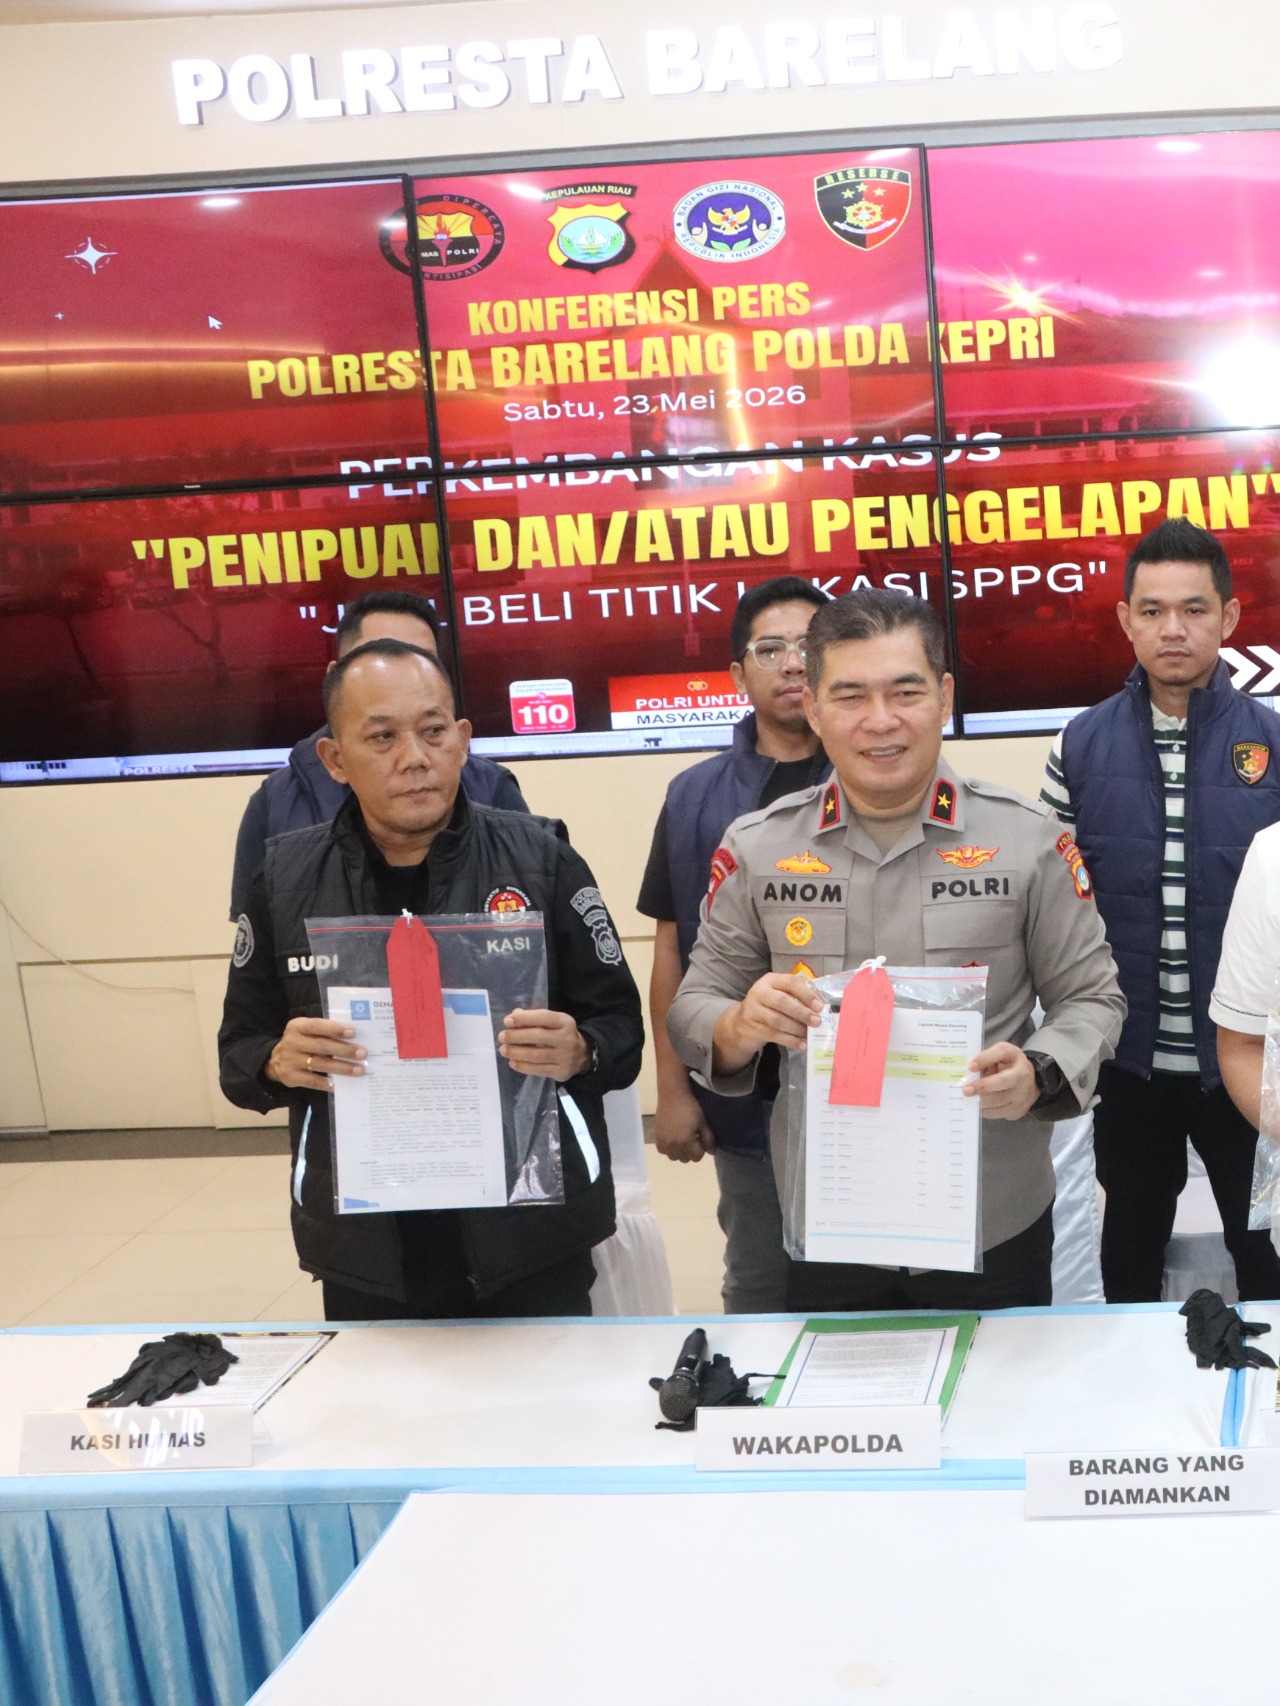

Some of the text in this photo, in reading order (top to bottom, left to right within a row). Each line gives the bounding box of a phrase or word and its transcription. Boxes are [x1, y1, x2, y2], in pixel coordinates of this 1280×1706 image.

[172, 4, 1124, 126] POLRESTA BARELANG
[824, 168, 900, 185] RESERSE
[545, 185, 632, 200] KEPULAUAN RIAU
[677, 184, 780, 217] BADAN GIZI NASIONAL
[442, 195, 503, 245] DIPERCAYA
[419, 250, 440, 258] MAS
[680, 228, 781, 259] REPUBLIK INDONESIA
[423, 263, 482, 280] RTISIPASI
[468, 281, 811, 336] KONFERENSI PERS
[247, 316, 1055, 399] POLRESTA BARELANG POLDA KEPRI
[503, 398, 605, 422] Sabtu,
[659, 388, 716, 413] Mei
[728, 384, 807, 408] 2026
[473, 502, 790, 572] DAN/ATAU
[462, 591, 573, 626] BELI
[588, 582, 721, 618] TITIK
[952, 561, 1107, 600] SPPG"
[635, 694, 749, 710] POLRI UNTU
[518, 704, 569, 725] 110
[763, 882, 843, 902] ANOM
[931, 877, 1010, 900] POLRI
[486, 937, 530, 953] KASI
[287, 953, 339, 973] BUDI
[70, 1431, 207, 1451] KASI HUMAS
[732, 1433, 904, 1455] WAKAPOLDA
[1068, 1453, 1245, 1477] BARANG YANG
[1084, 1484, 1232, 1507] DIAMANKAN
